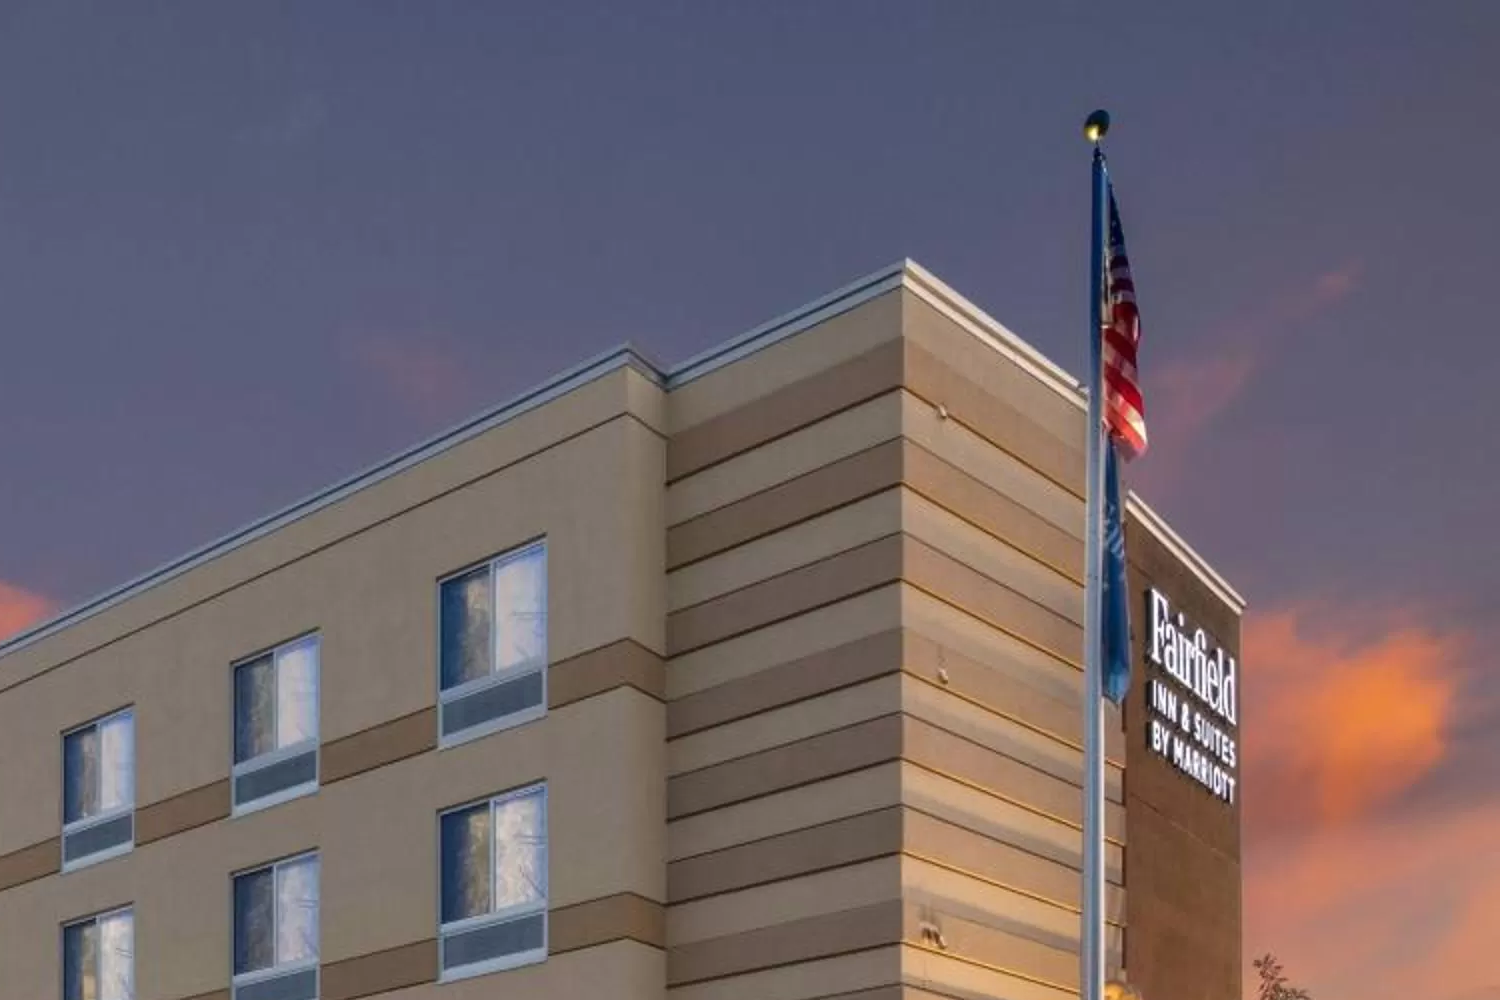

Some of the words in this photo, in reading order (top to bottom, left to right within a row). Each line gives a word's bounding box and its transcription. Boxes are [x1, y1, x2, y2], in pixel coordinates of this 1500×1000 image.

[1151, 587, 1237, 725] Fairfield
[1152, 720, 1170, 758] BY
[1173, 737, 1236, 804] MARRIOTT
[1153, 680, 1177, 723] INN
[1181, 703, 1191, 732] &
[1195, 712, 1237, 768] SUITES
